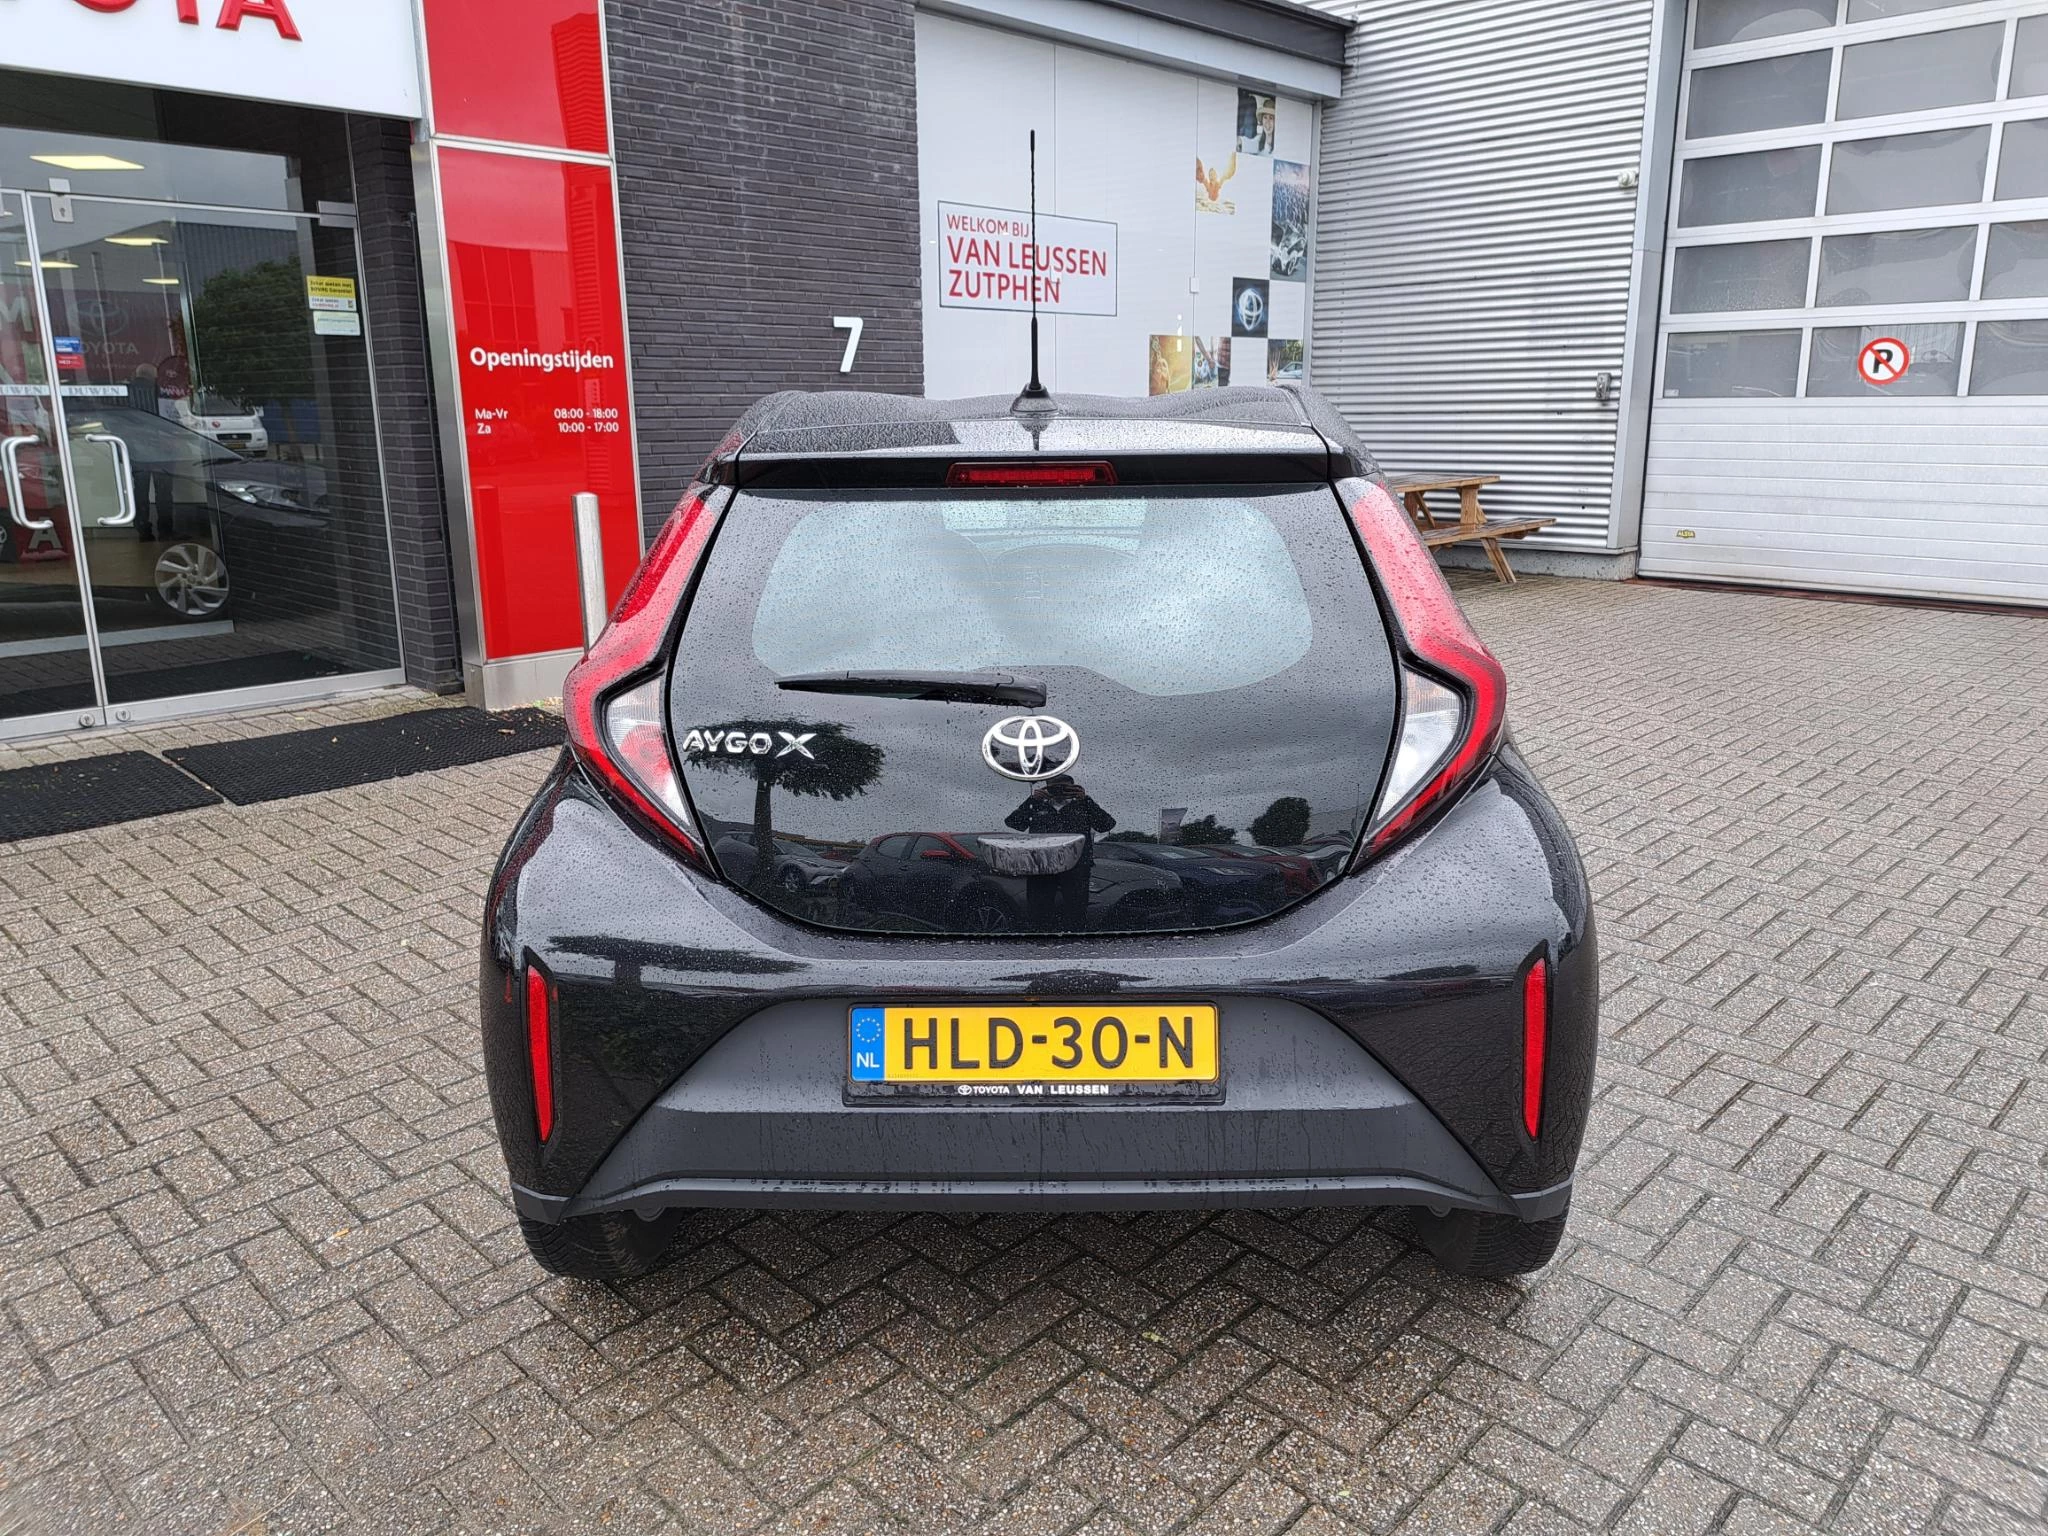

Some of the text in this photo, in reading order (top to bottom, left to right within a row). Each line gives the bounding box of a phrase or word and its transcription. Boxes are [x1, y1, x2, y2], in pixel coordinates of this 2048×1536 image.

[946, 213, 1030, 238] WELKOM BIJ
[946, 235, 1107, 277] VAN LEUSSEN
[948, 269, 1061, 304] ZUTPHEN
[833, 316, 864, 373] 7
[470, 347, 614, 372] Openingstijden
[474, 407, 509, 420] Ma-Vr
[554, 407, 584, 419] 08:00
[592, 407, 618, 419] 18:00
[477, 422, 492, 435] Za
[558, 421, 585, 433] 10:00
[593, 421, 619, 433] 17:00
[682, 729, 818, 760] AYGO X
[904, 1016, 1194, 1070] HLD-30-N
[856, 1051, 880, 1069] NL
[972, 1084, 1109, 1096] TOYOTA VAN LEUSSEN
